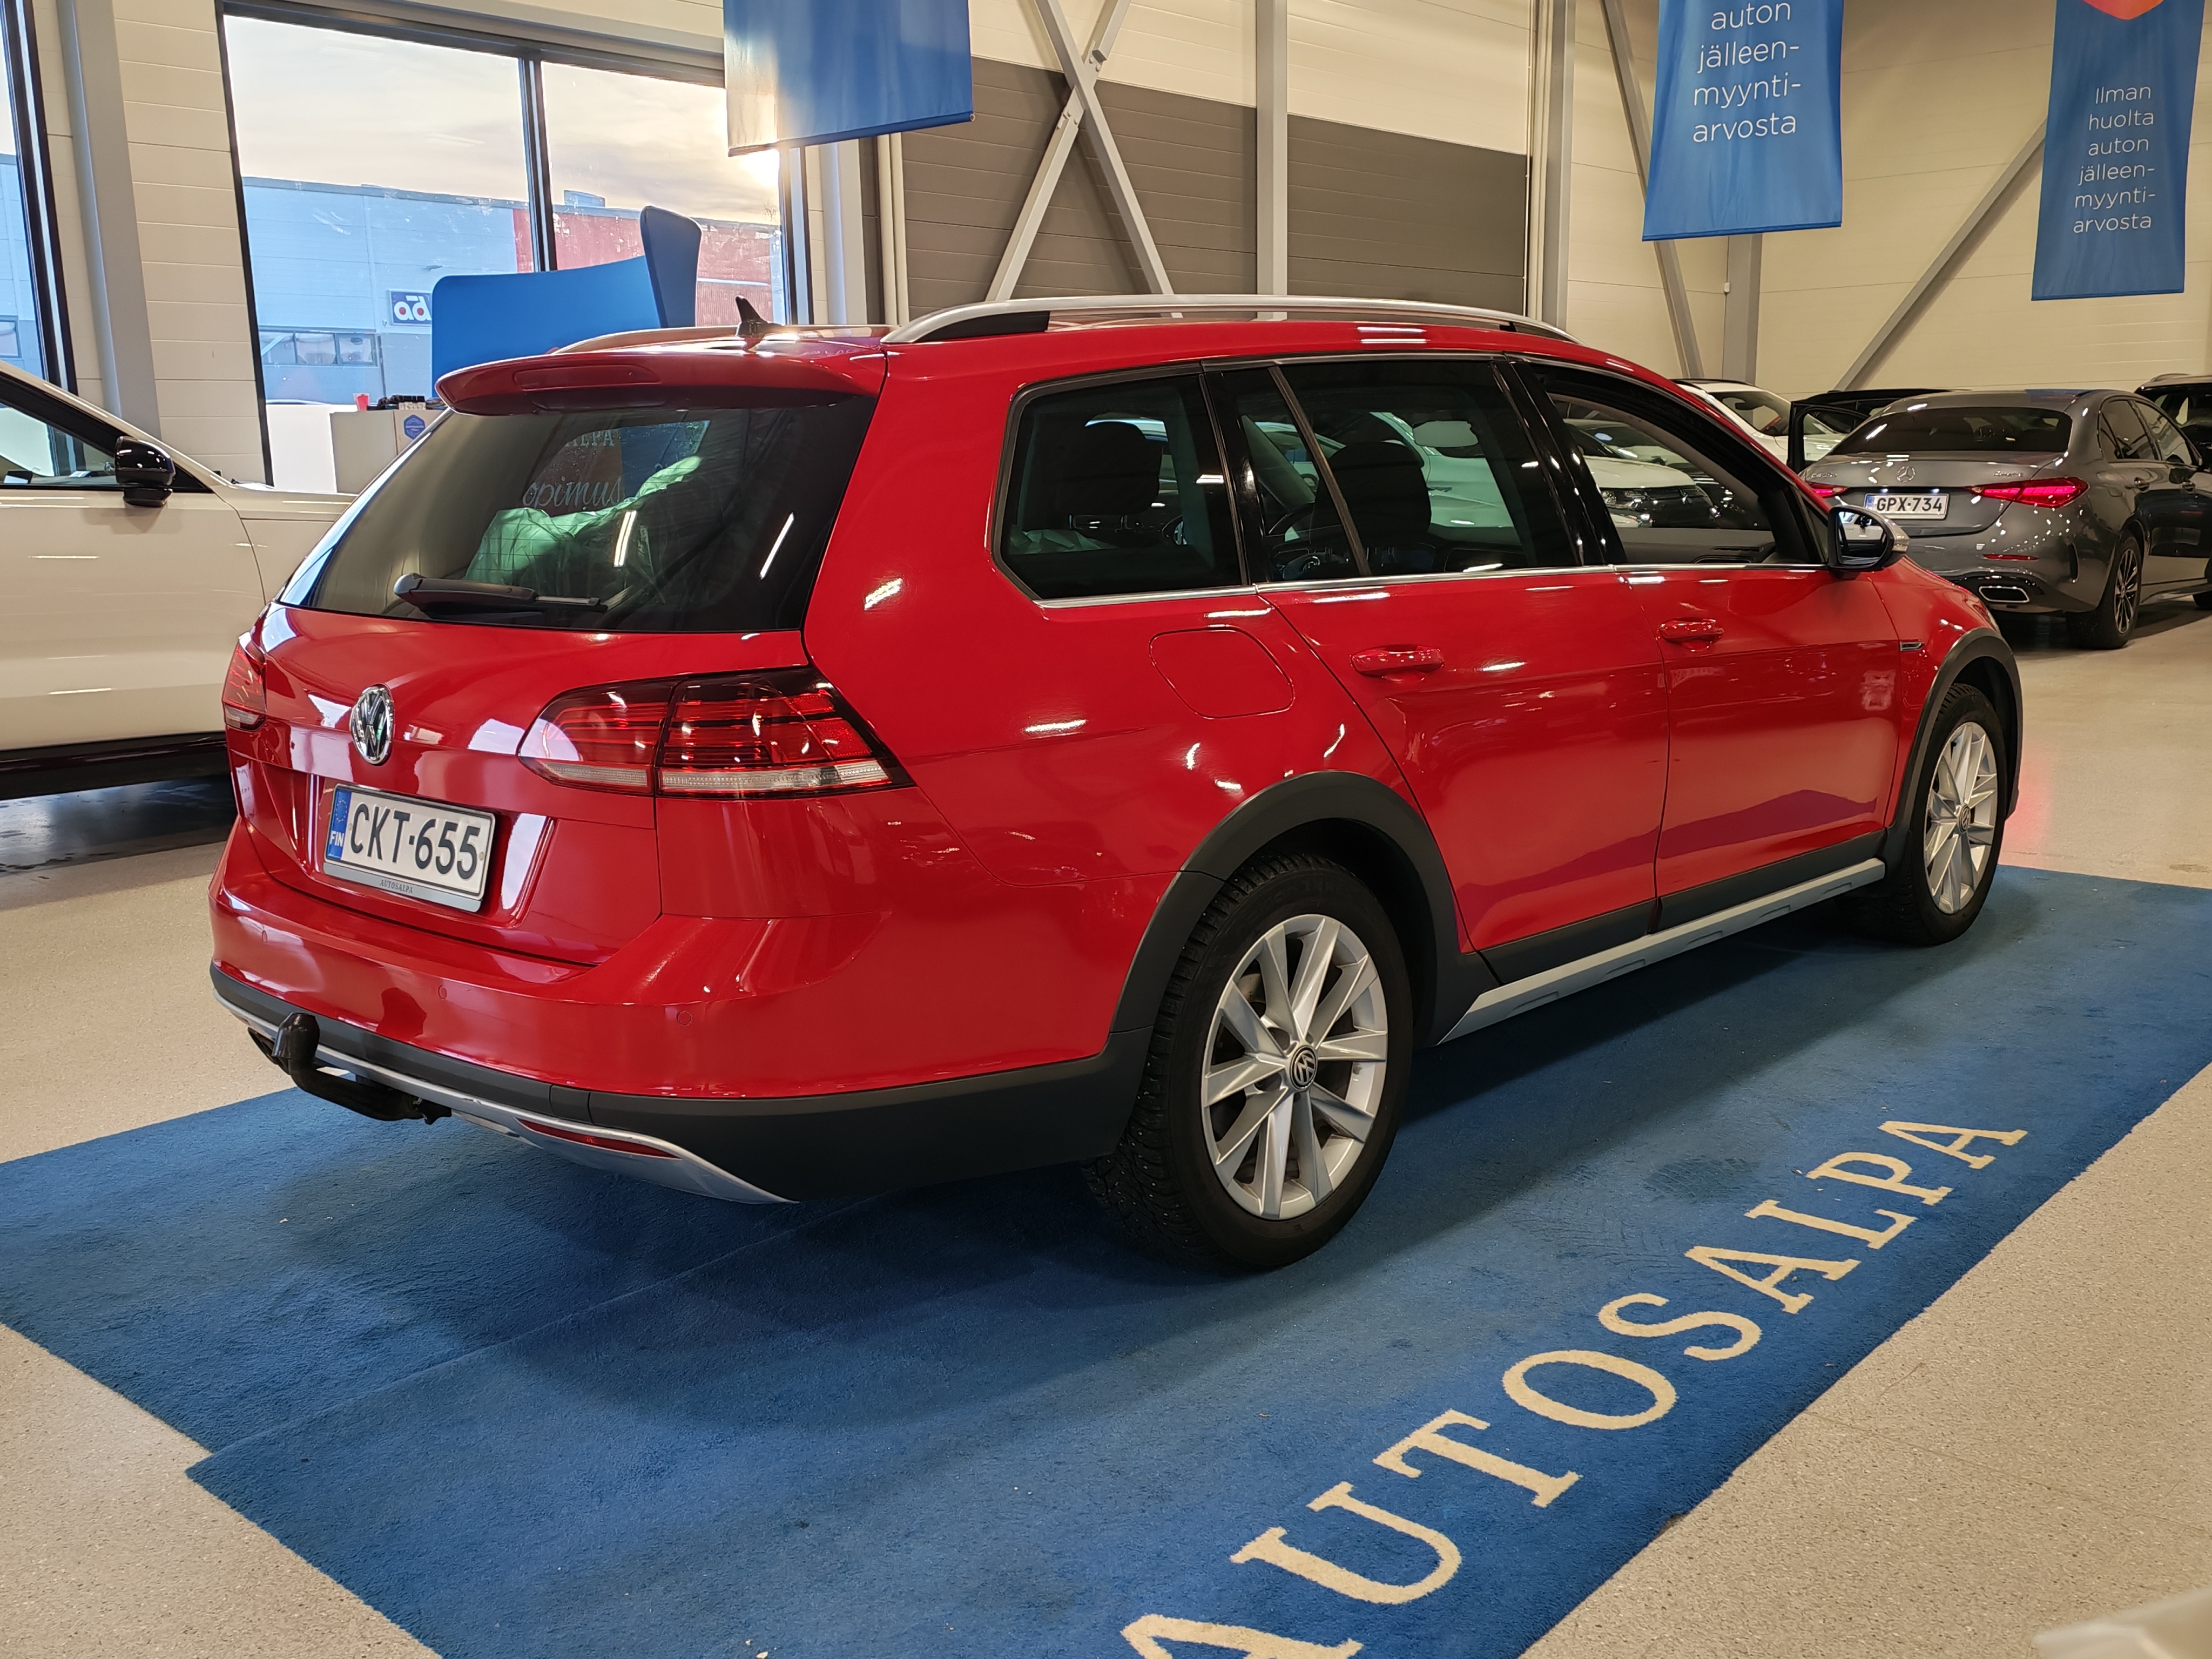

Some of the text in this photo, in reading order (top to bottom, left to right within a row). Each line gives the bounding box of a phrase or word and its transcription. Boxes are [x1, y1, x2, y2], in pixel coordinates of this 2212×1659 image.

[1711, 2, 1791, 30] auton
[1697, 41, 1799, 73] jälleen-
[1694, 72, 1801, 109] myynti-
[2095, 86, 2152, 104] Ilman
[1693, 112, 1796, 143] arvosta
[2088, 109, 2154, 131] huolta
[2088, 137, 2149, 156] auton
[2078, 163, 2155, 186] jälleen-
[2075, 186, 2156, 210] myynti-
[2073, 213, 2152, 234] arvosta
[1877, 497, 1943, 512] GPX-734
[330, 803, 481, 880] FIN CKT-655
[380, 879, 413, 894] AUTOSALPA
